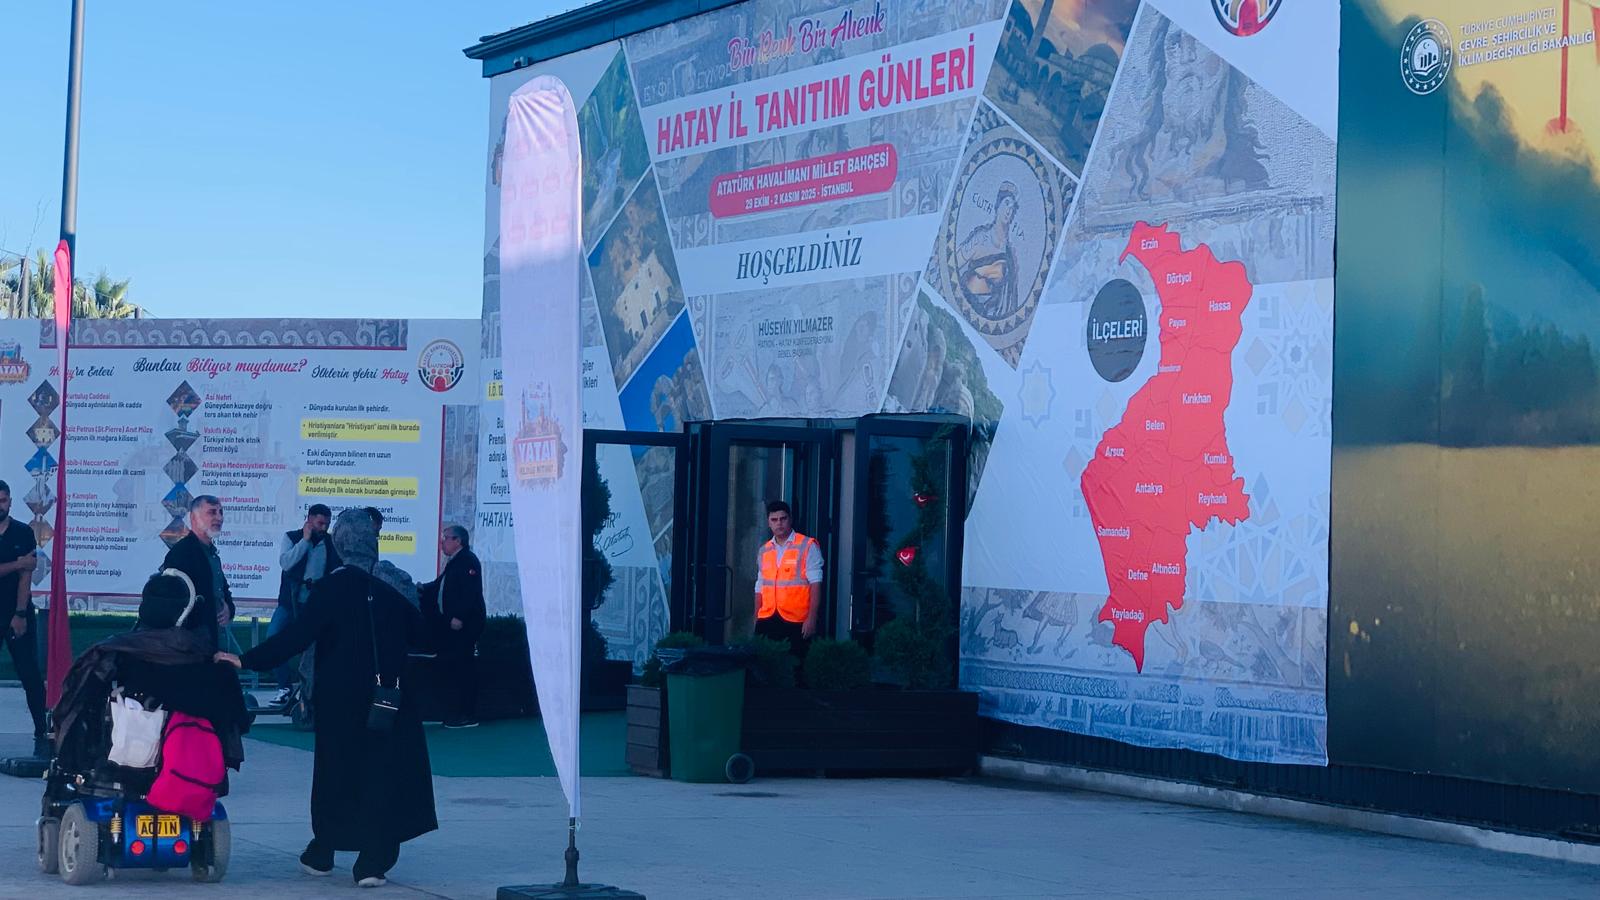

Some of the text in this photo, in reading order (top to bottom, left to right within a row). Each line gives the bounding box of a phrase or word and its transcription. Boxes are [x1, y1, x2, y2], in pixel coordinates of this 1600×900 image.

[799, 18, 826, 53] Bir
[1544, 24, 1556, 35] VE
[1458, 51, 1485, 67] İKLİM
[657, 104, 723, 155] HATAY
[729, 91, 748, 139] İL
[755, 74, 850, 134] TANITIM
[858, 33, 975, 112] GÜNLERİ
[717, 147, 889, 196] ATATÜRK HAVALİMANI MİLLET BAHÇESİ
[753, 195, 770, 208] EKİM
[774, 194, 779, 205] 2
[780, 191, 800, 205] KASIM
[801, 188, 816, 201] 2025
[821, 181, 854, 199] İSTANBUL
[1141, 239, 1158, 249] Erzin
[736, 230, 863, 284] HOŞGELDİNİZ
[1166, 271, 1192, 285] Dörtyol
[1208, 300, 1231, 312] Hassa
[758, 316, 833, 336] HÜSEYİN YILMAZER
[1092, 314, 1143, 343] İLÇELERİ
[0, 365, 25, 375] ATAY
[88, 365, 115, 377] Enleri
[133, 357, 308, 379] Bunları Biliyor muydunuz?
[311, 365, 349, 379] İlklerin
[381, 369, 409, 384] Hatay
[89, 392, 110, 400] Caddesi
[1182, 392, 1212, 404] Kırıkhan
[204, 402, 272, 411] Güneyden kuzeye doğru
[308, 404, 334, 412] Dünyada
[366, 405, 390, 413] şehirdir.
[308, 422, 345, 430] Hristiyanlara
[1145, 420, 1165, 431] Belen
[224, 445, 238, 453] köyü
[307, 449, 319, 457] Eski
[320, 449, 346, 458] dünyanın
[347, 450, 367, 458] bilinen
[326, 459, 356, 467] buradadır.
[1204, 453, 1227, 465] Kumlu
[202, 470, 232, 478] Türkiyenin
[305, 477, 388, 486] Fetihler dışında müslümanlık
[305, 486, 336, 494] Anadoluya
[390, 489, 417, 497] girmiştir.
[1135, 482, 1163, 495] Antakya
[1198, 492, 1227, 505] Reyhanlı
[1097, 526, 1130, 539] Samandağ
[1128, 569, 1148, 580] Defne
[1151, 562, 1180, 575] Altınözü
[1111, 608, 1144, 623] Yayladağı
